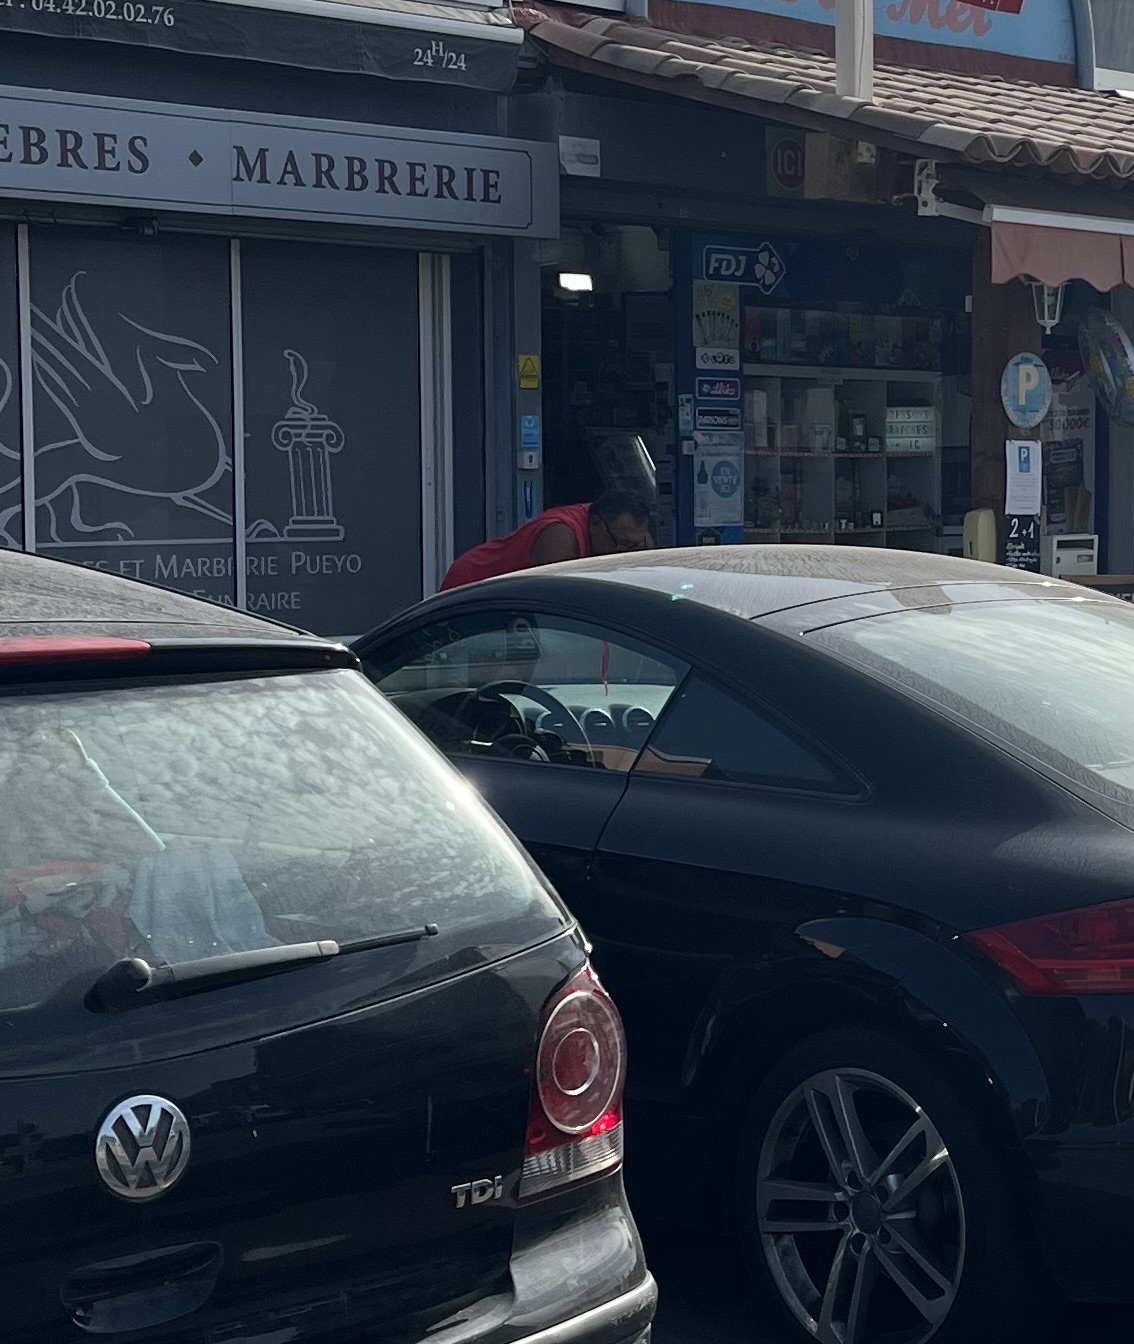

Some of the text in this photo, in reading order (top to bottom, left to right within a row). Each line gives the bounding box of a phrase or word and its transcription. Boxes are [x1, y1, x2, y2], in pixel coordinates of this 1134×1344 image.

[233, 144, 502, 205] MARBRERIE
[708, 253, 747, 277] FDJ
[1018, 363, 1040, 406] P
[155, 554, 278, 579] MARBRIE
[291, 551, 362, 575] PUEYO
